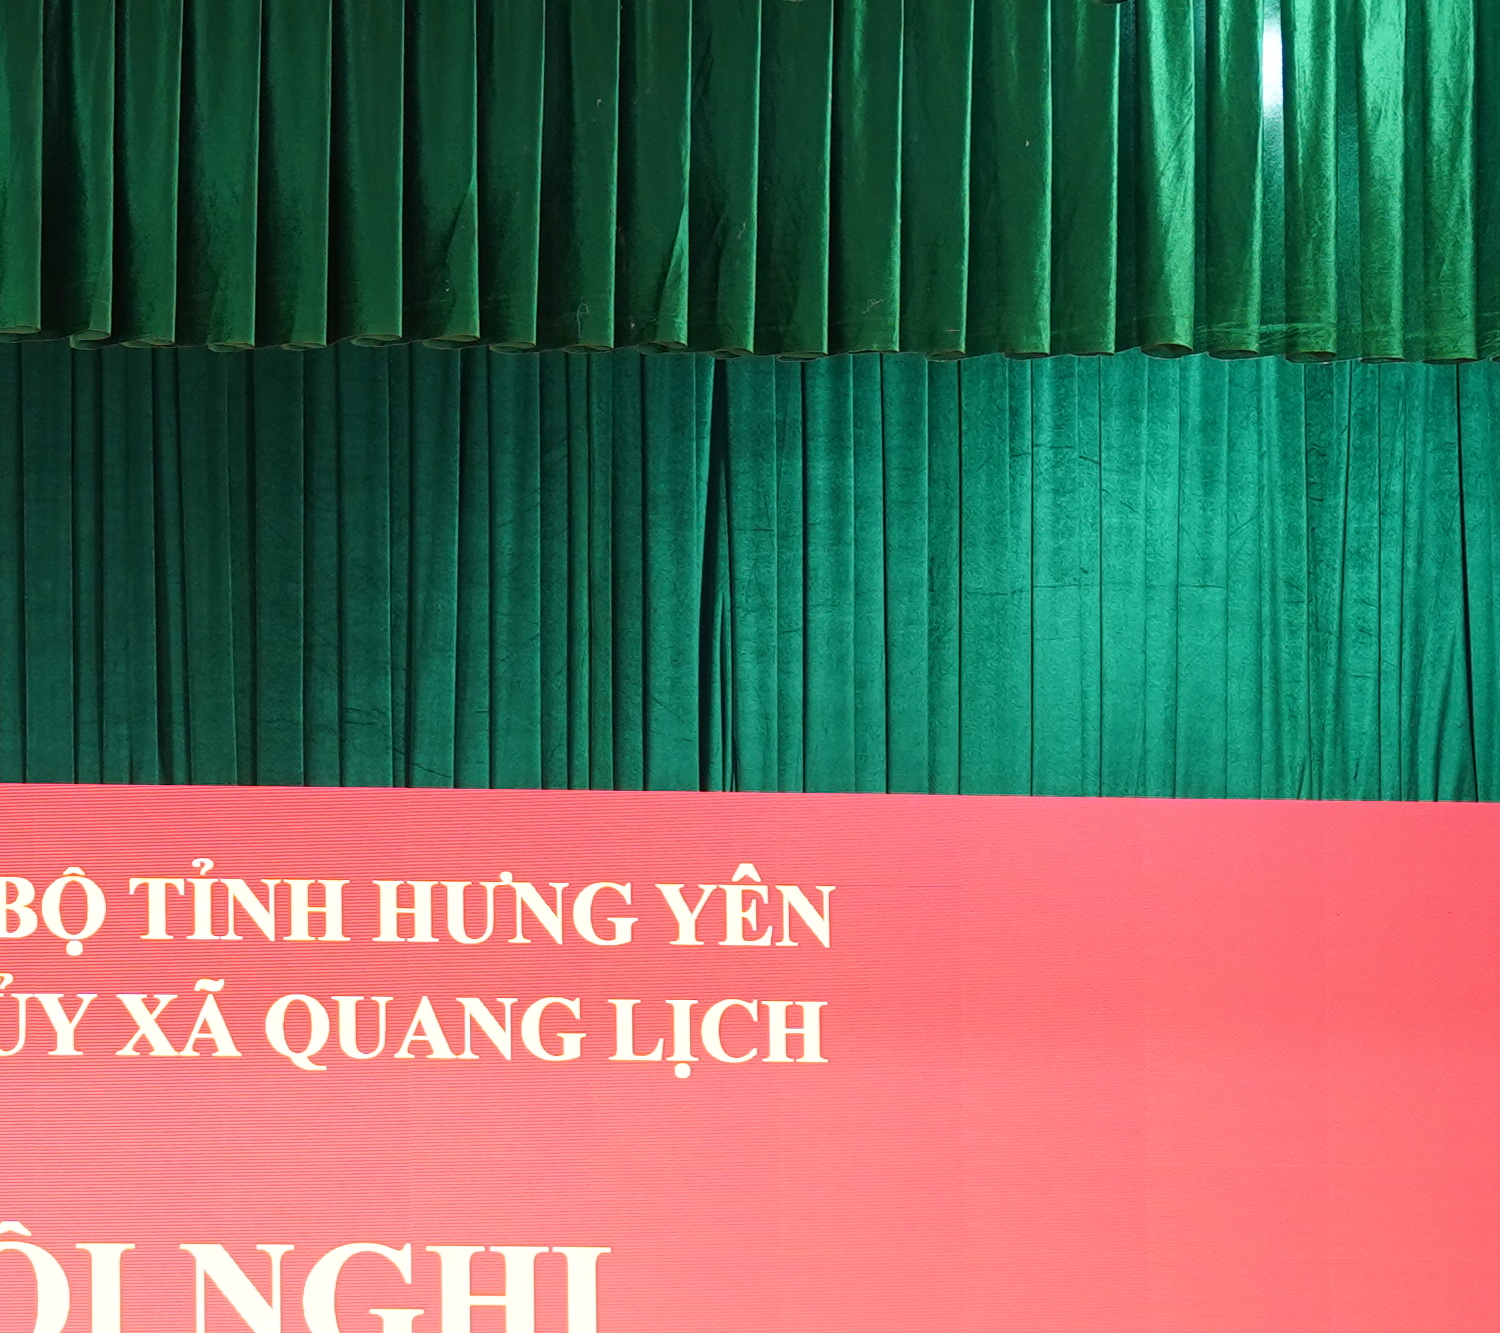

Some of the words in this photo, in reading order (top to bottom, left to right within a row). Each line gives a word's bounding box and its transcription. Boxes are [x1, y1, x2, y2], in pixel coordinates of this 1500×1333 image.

[130, 857, 350, 942] TỈNH
[373, 871, 638, 946] HƯNG
[656, 862, 835, 948] YÊN
[116, 978, 242, 1057] XÃ
[266, 994, 586, 1071] QUANG
[608, 998, 828, 1079] LỊCH
